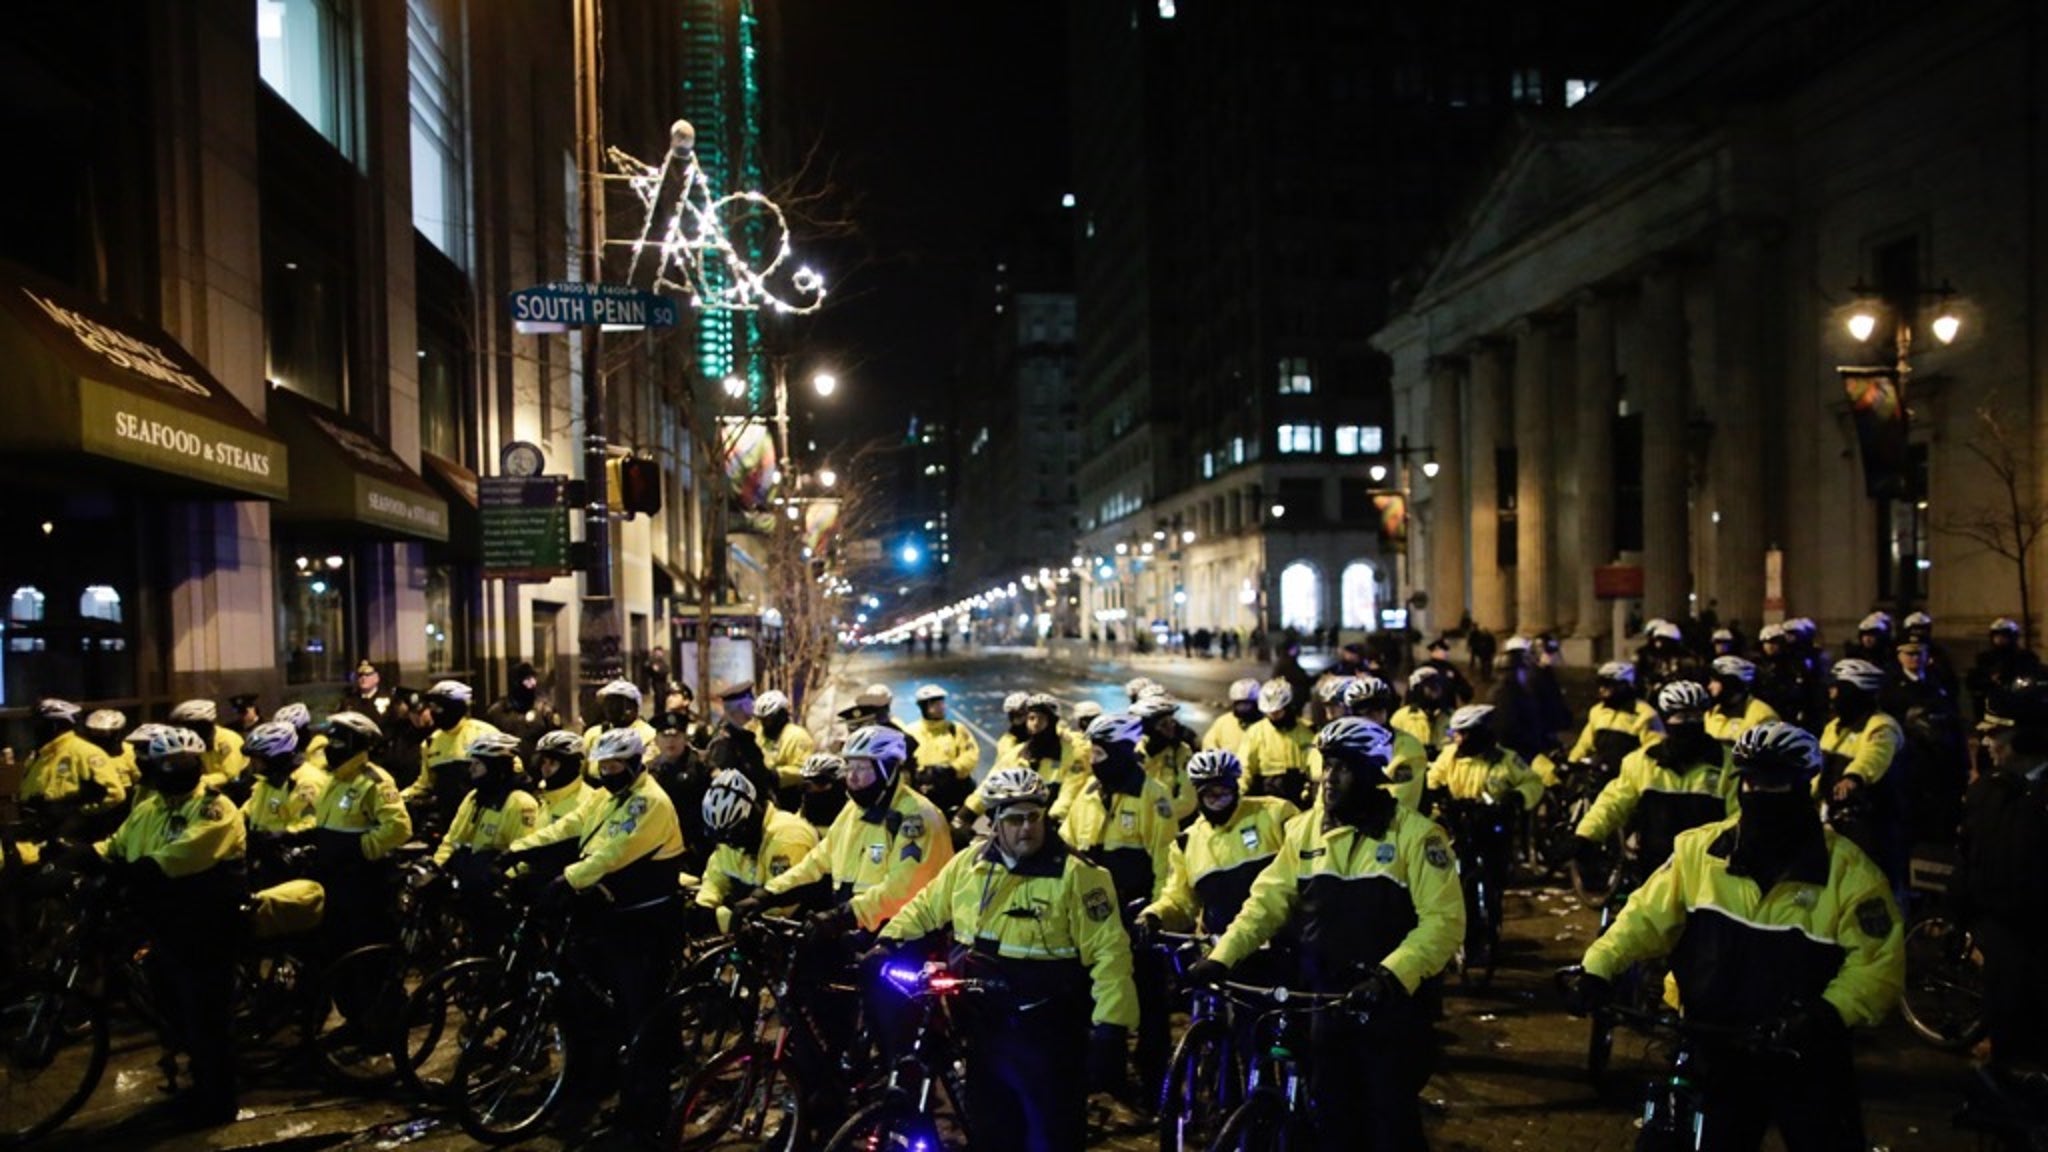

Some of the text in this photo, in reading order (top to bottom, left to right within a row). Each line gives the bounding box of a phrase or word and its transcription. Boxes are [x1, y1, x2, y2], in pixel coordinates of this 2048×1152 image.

[559, 283, 629, 297] 1300 W 1400
[515, 294, 674, 325] SOUTH PENN SQ
[115, 411, 202, 457] SEAFOOD
[203, 443, 215, 462] &
[216, 441, 271, 477] STEAKS
